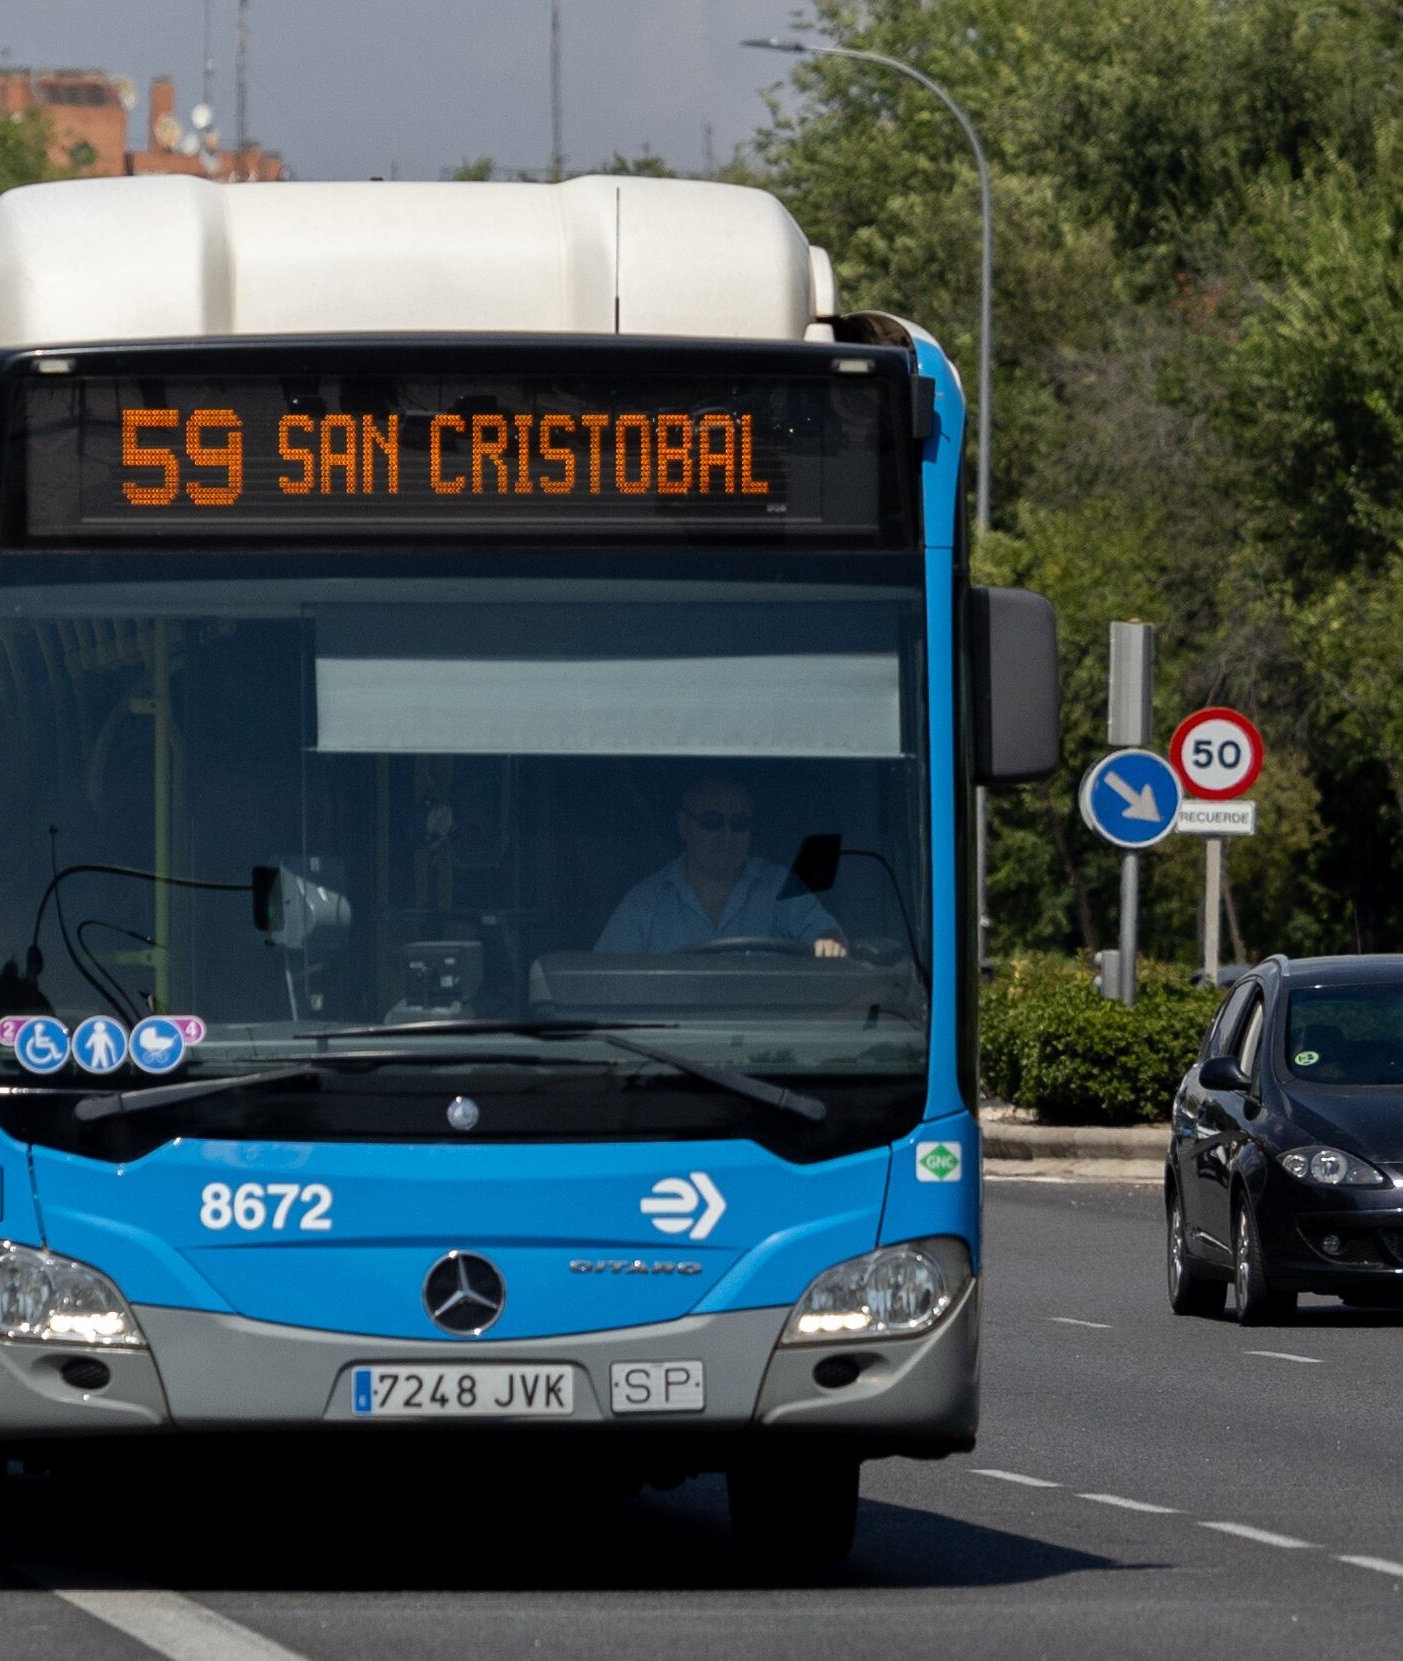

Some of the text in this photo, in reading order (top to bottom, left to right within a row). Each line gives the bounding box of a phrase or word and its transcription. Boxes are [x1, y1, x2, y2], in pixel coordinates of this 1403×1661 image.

[122, 409, 770, 505] 59 SAN CRISTOBAL
[1192, 740, 1241, 769] 50
[1179, 811, 1250, 824] RECUERDE
[3, 1021, 15, 1038] 2
[185, 1021, 197, 1038] 4
[926, 1155, 956, 1169] GNC
[199, 1182, 333, 1230] 8672
[378, 1374, 565, 1408] 7248 JVK
